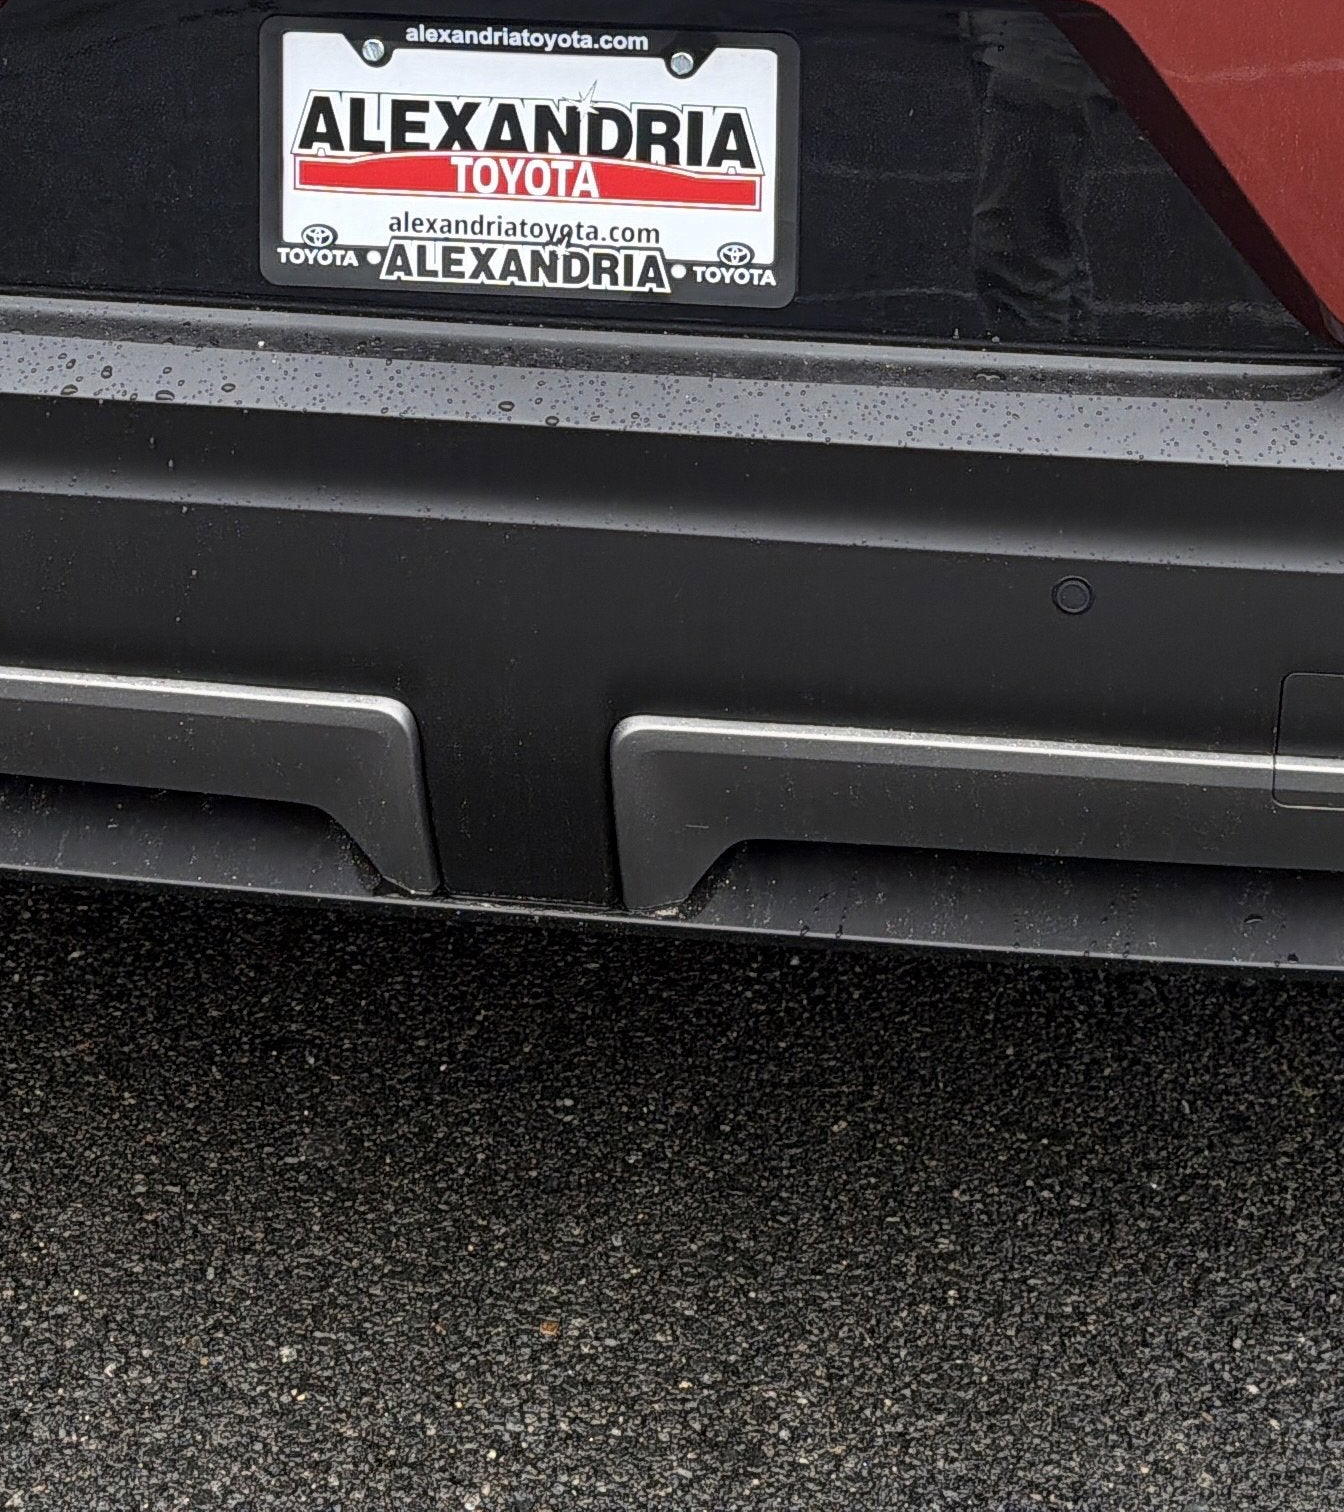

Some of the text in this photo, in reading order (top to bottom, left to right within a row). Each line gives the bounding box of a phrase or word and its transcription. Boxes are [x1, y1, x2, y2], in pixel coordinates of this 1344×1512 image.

[405, 24, 649, 53] alexandriatoyota.com
[297, 94, 758, 170] ALEXANDRIA
[450, 156, 601, 199] TOYOTA
[388, 211, 661, 245] alexandriatoyota.com
[277, 247, 359, 269] TOYOTA
[382, 240, 671, 293] ALEXANDRIA
[692, 265, 777, 287] TOYOTA
